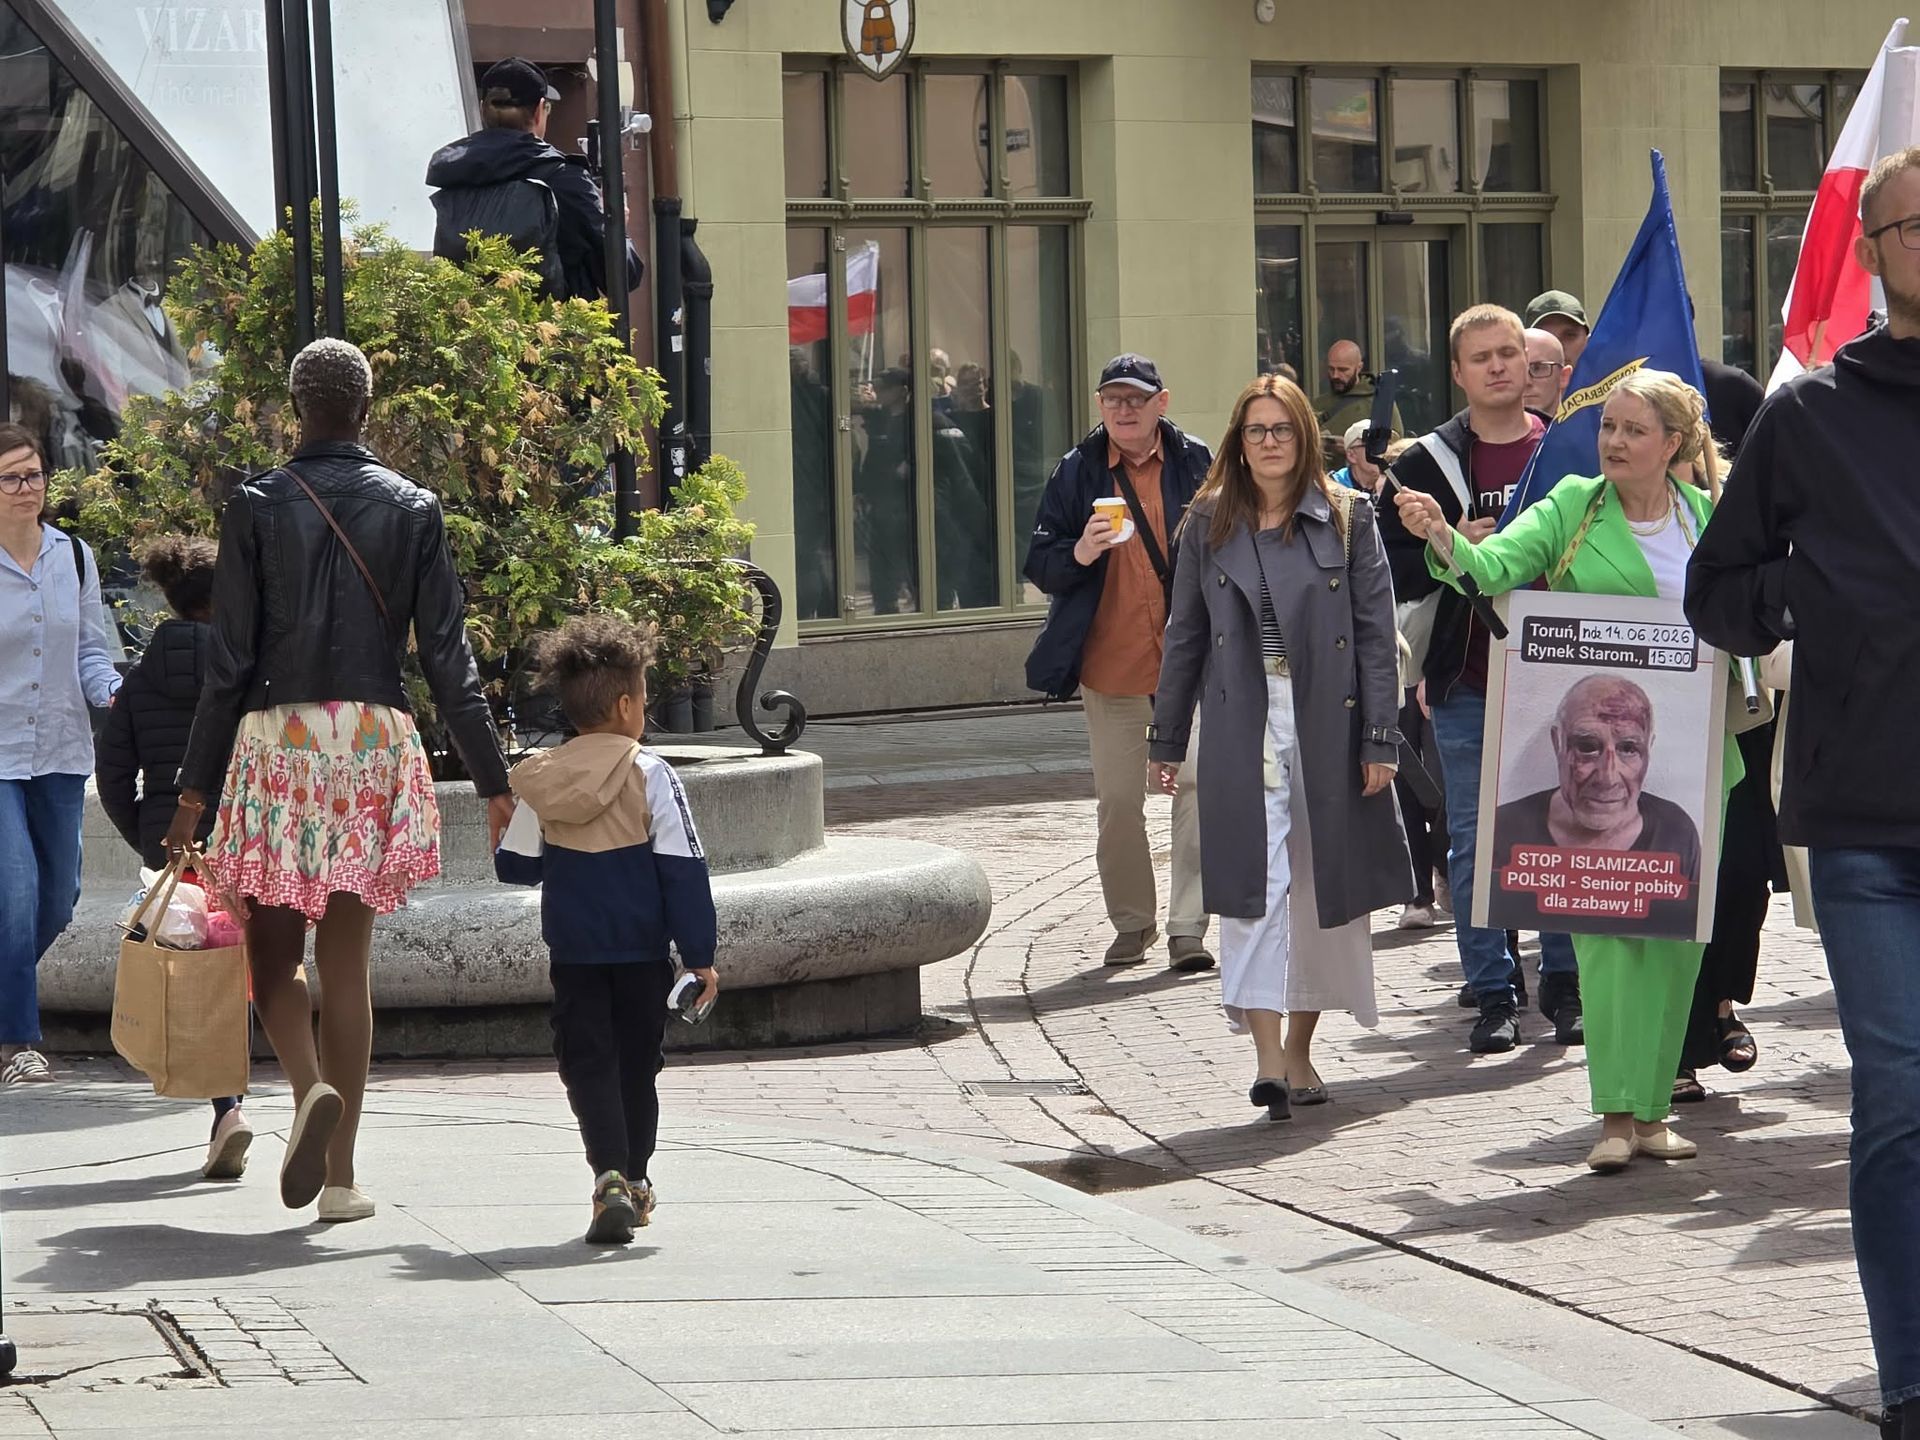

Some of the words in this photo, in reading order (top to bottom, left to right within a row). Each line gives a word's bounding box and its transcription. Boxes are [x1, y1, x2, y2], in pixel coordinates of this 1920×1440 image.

[1529, 623, 1577, 642] Toruń,
[1527, 643, 1575, 660] Rynek
[1579, 647, 1643, 665] Starom.,
[1650, 651, 1691, 665] 15:00
[1518, 852, 1562, 867] STOP
[1570, 855, 1674, 874] ISLAMIZACJI
[1507, 872, 1565, 888] POLSKI
[1581, 876, 1631, 892] Senior
[1634, 879, 1683, 898] pobity
[1544, 894, 1567, 908] dla
[1571, 895, 1630, 914] zabawy
[1634, 898, 1643, 912] !!
